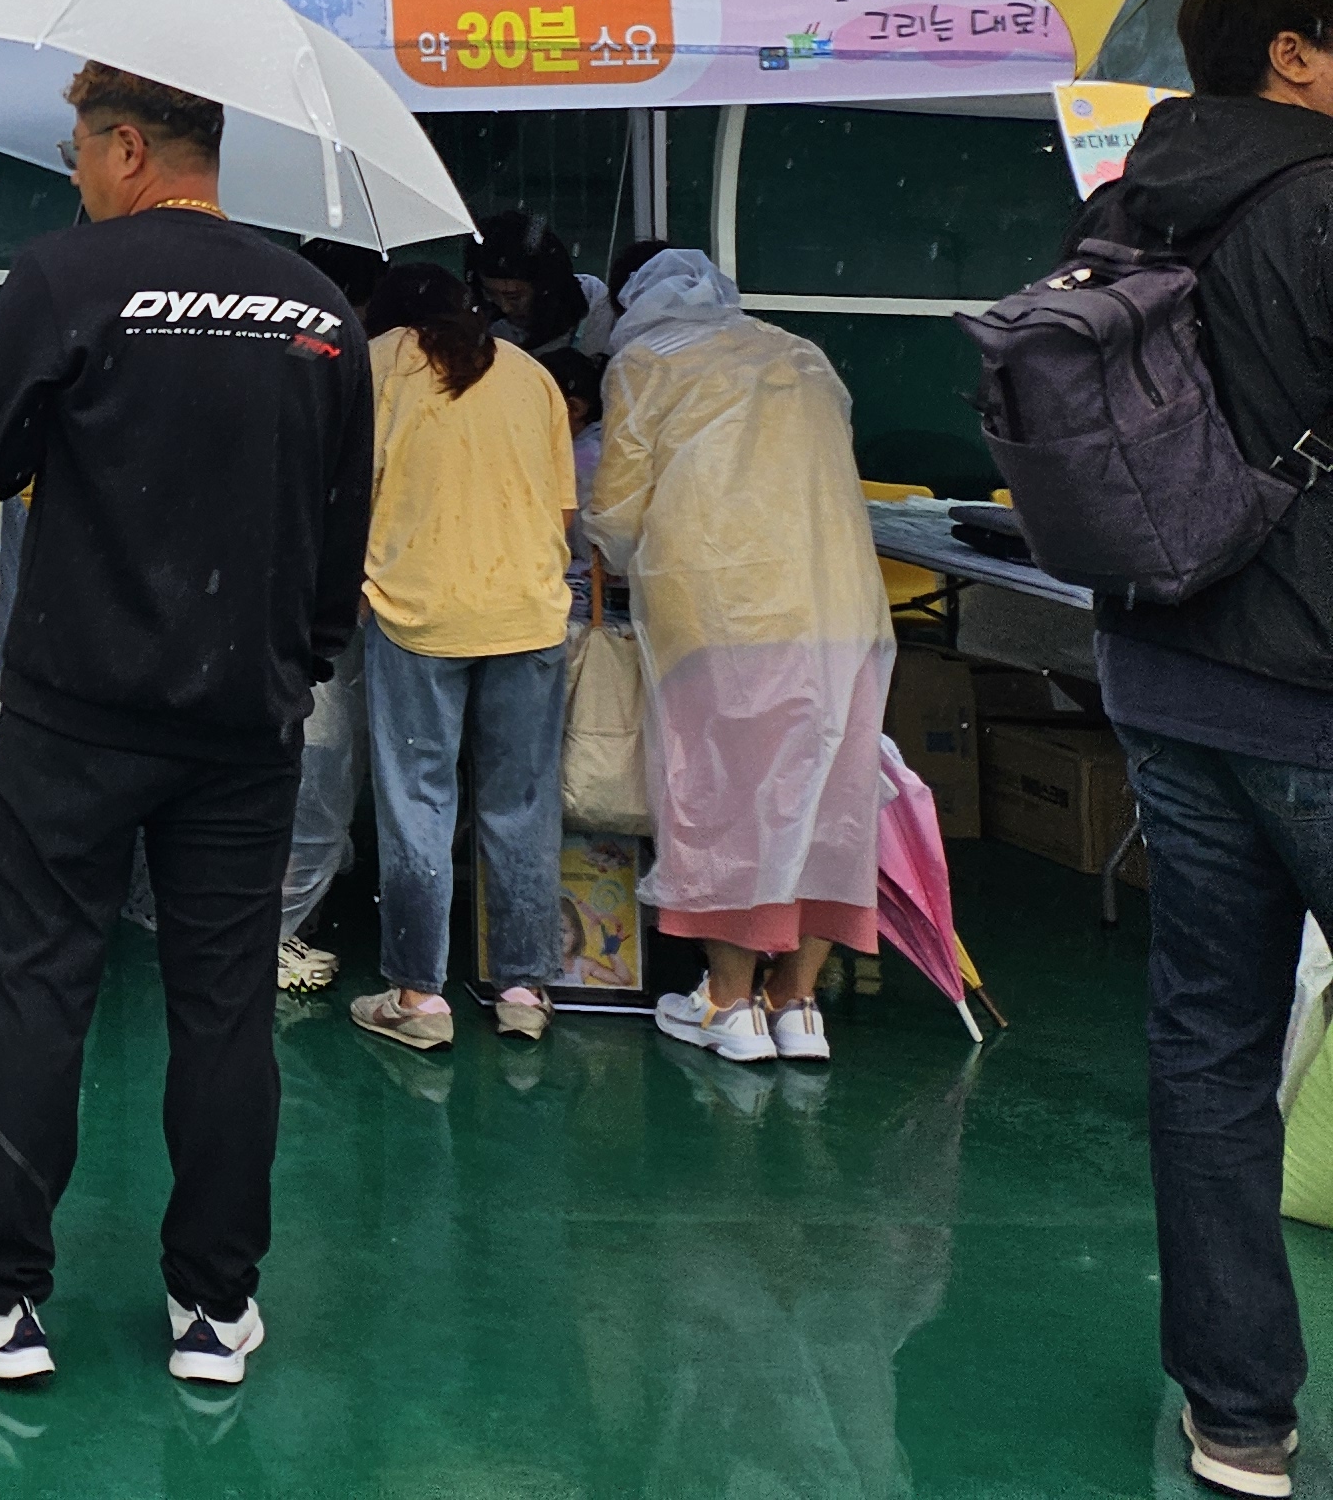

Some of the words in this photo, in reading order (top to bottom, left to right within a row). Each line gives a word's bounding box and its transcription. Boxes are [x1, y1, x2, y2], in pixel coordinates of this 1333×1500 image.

[418, 31, 451, 73] 약
[456, 5, 581, 73] 30분
[589, 24, 660, 67] 소요
[863, 4, 954, 42] 그리는
[970, 2, 1050, 38] 대로!
[119, 290, 344, 335] DYNAFIT
